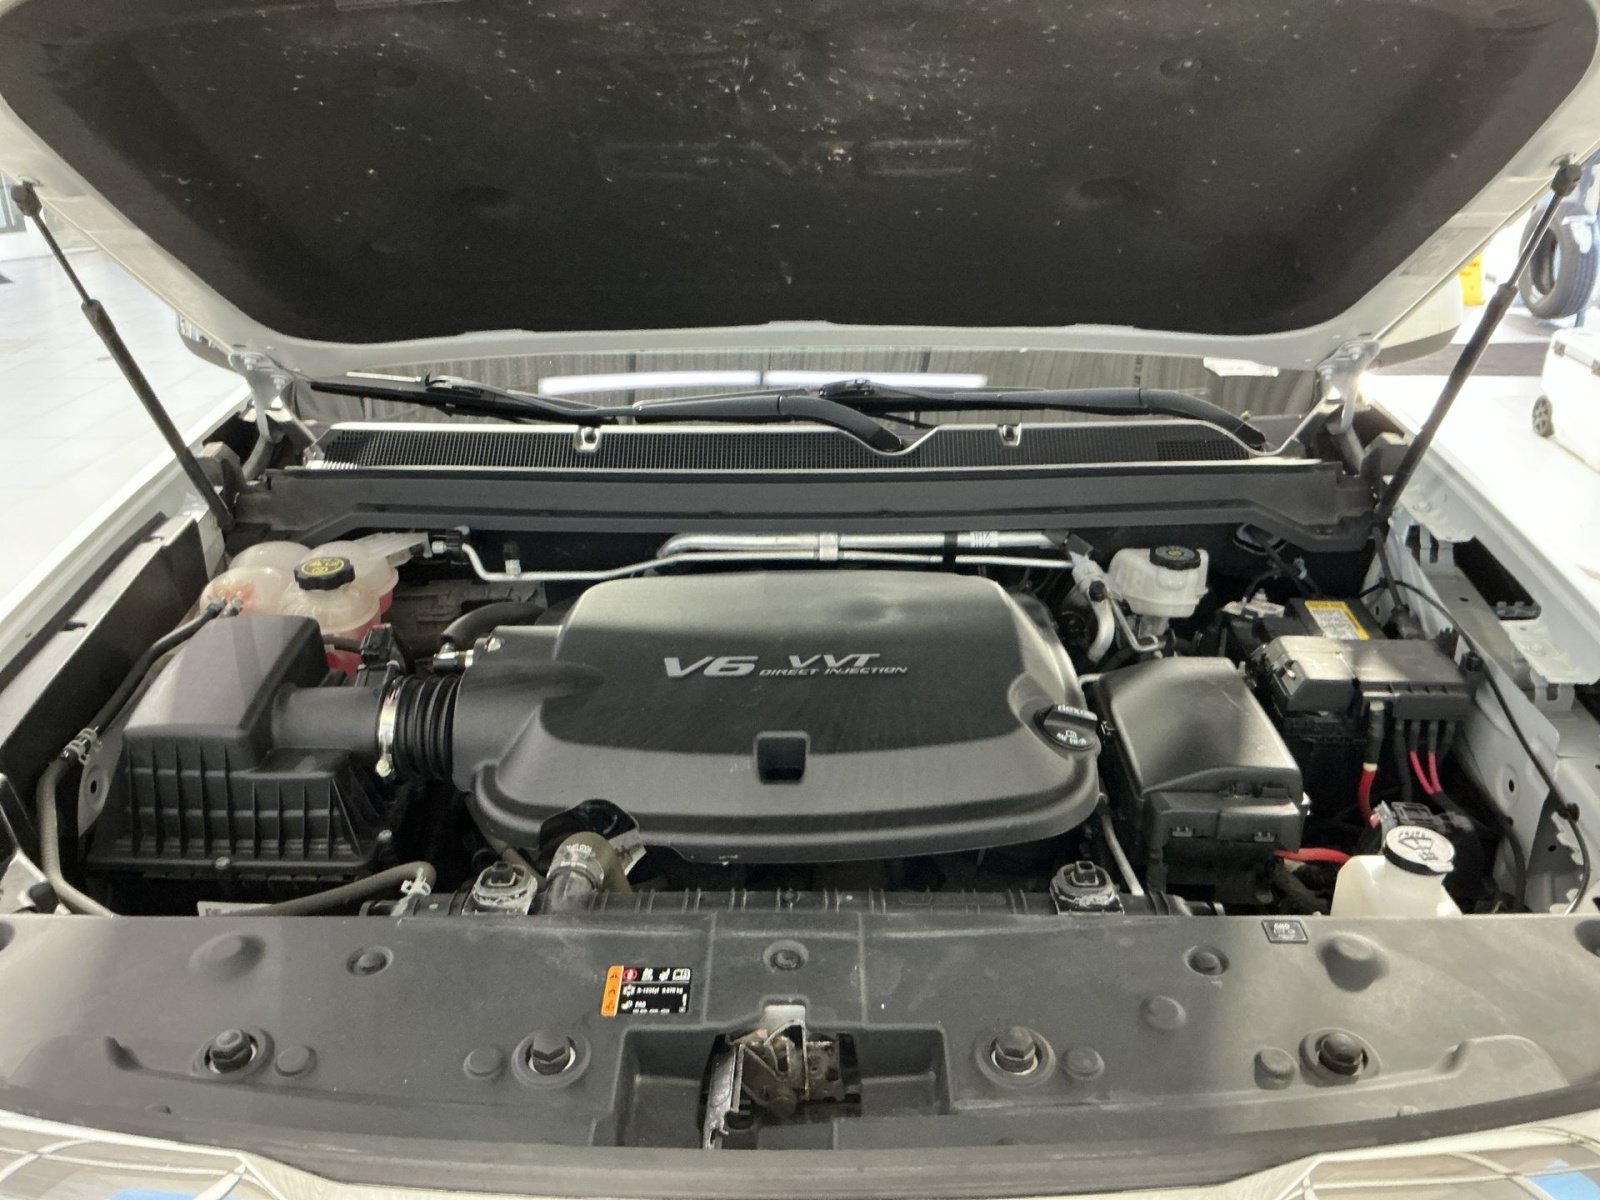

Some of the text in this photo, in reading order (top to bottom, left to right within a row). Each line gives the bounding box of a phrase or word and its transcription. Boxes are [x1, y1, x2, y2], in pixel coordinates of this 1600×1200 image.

[664, 656, 759, 678] V6
[789, 653, 881, 668] VVT
[759, 666, 908, 676] DIRECT INJECTION
